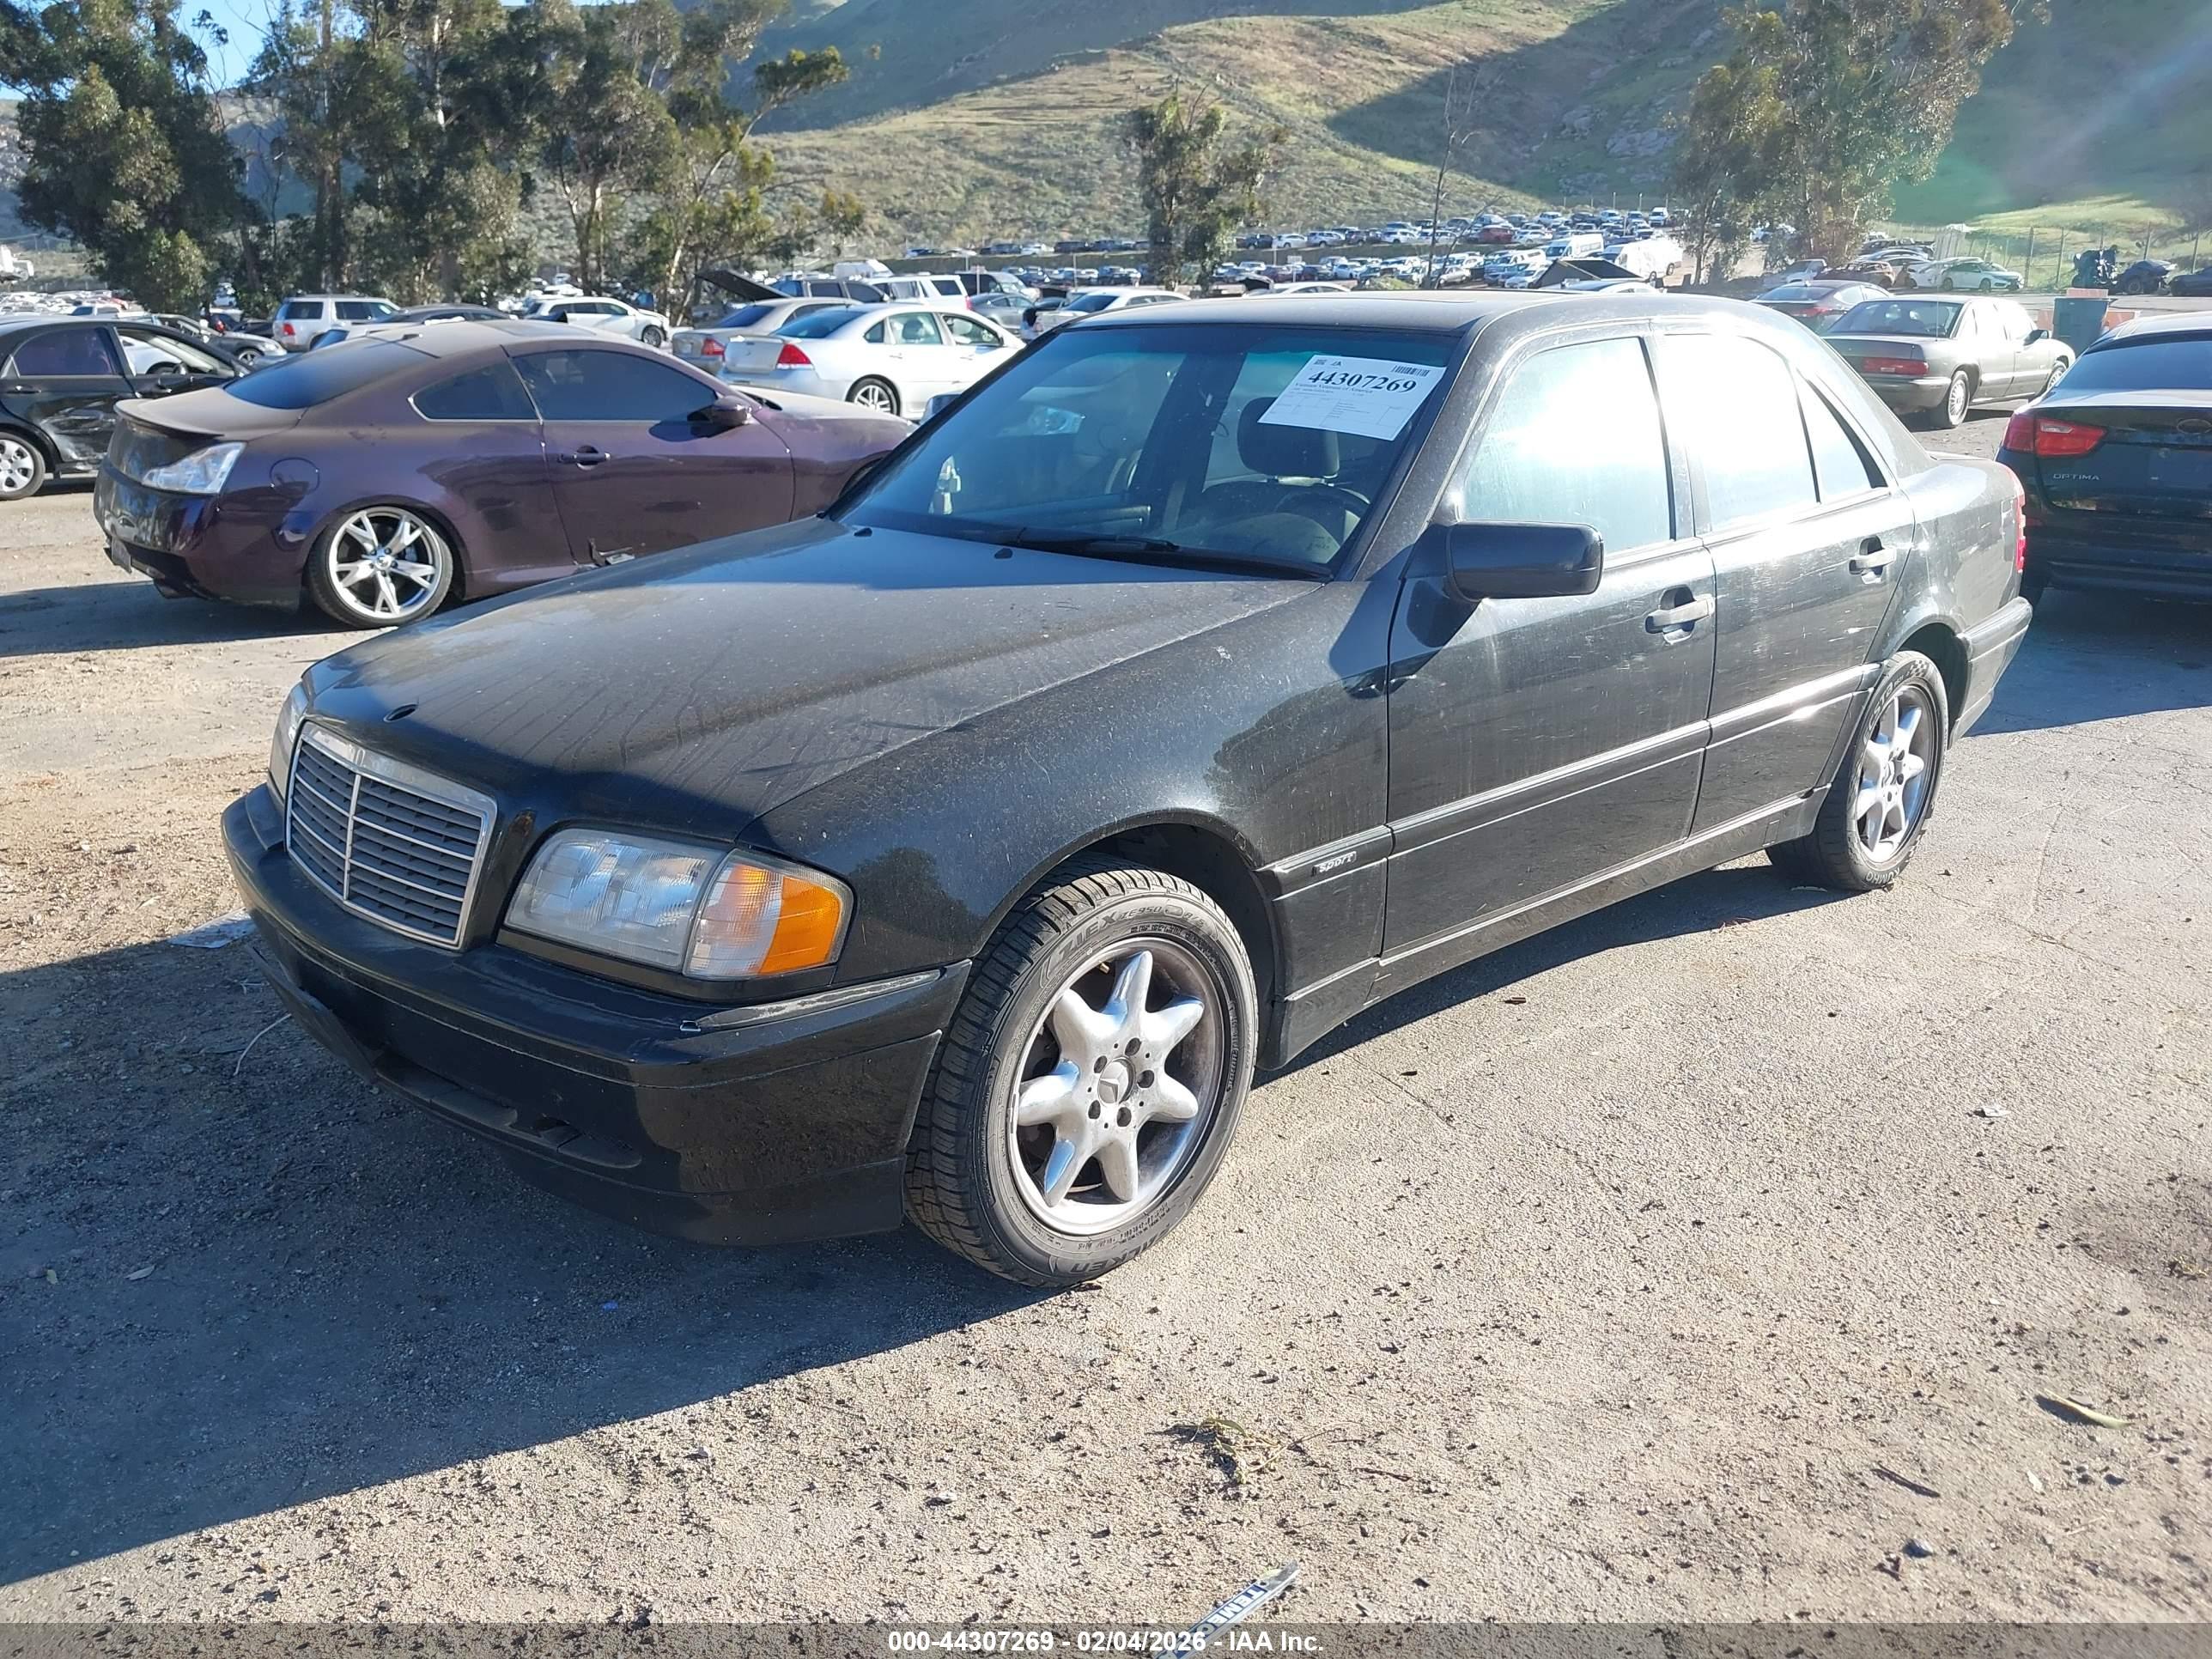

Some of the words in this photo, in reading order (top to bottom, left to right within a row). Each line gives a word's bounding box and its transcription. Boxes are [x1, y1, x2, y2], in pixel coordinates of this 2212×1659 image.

[1308, 370, 1417, 393] 44307269
[1866, 866, 1900, 884] KUMHO
[1058, 914, 1116, 956] ZIEX
